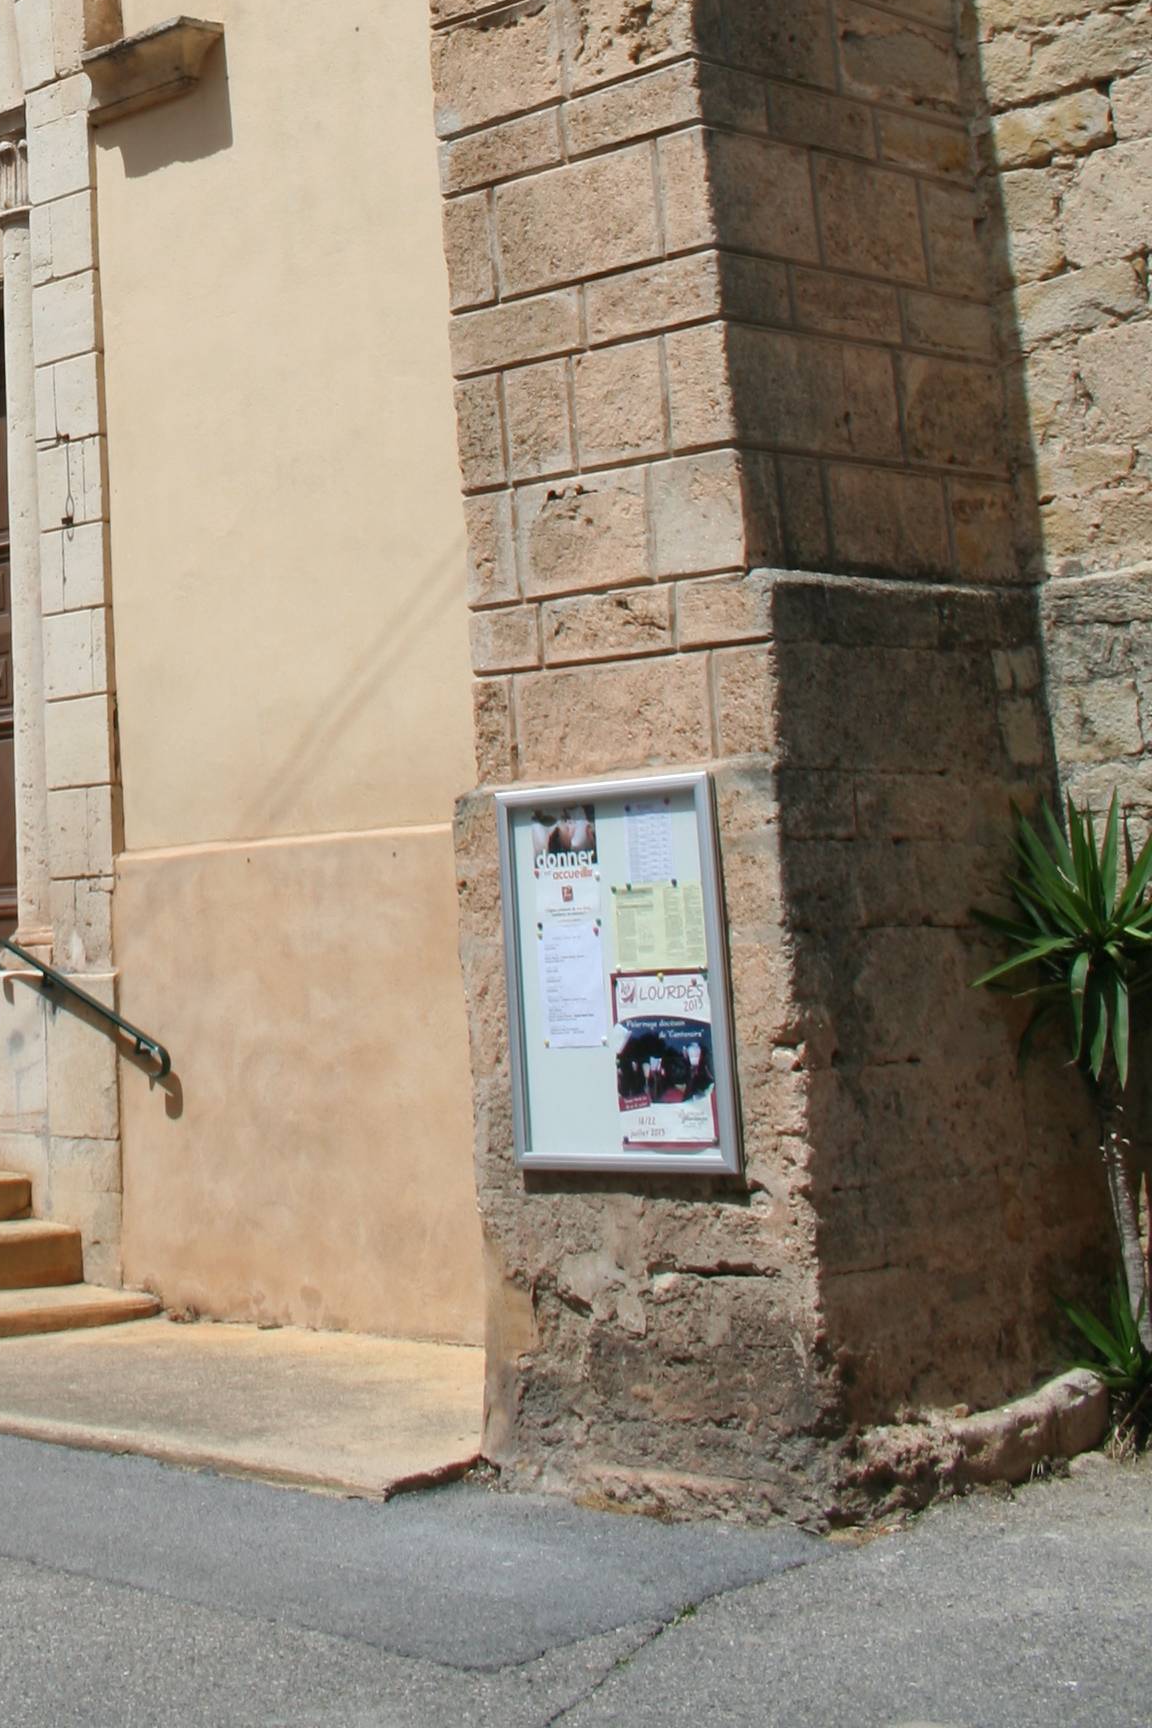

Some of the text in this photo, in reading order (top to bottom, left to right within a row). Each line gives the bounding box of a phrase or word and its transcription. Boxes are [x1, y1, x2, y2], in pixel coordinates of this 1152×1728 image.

[536, 849, 594, 870] donner
[639, 984, 704, 1001] LOURDES
[683, 997, 703, 1012] 2013
